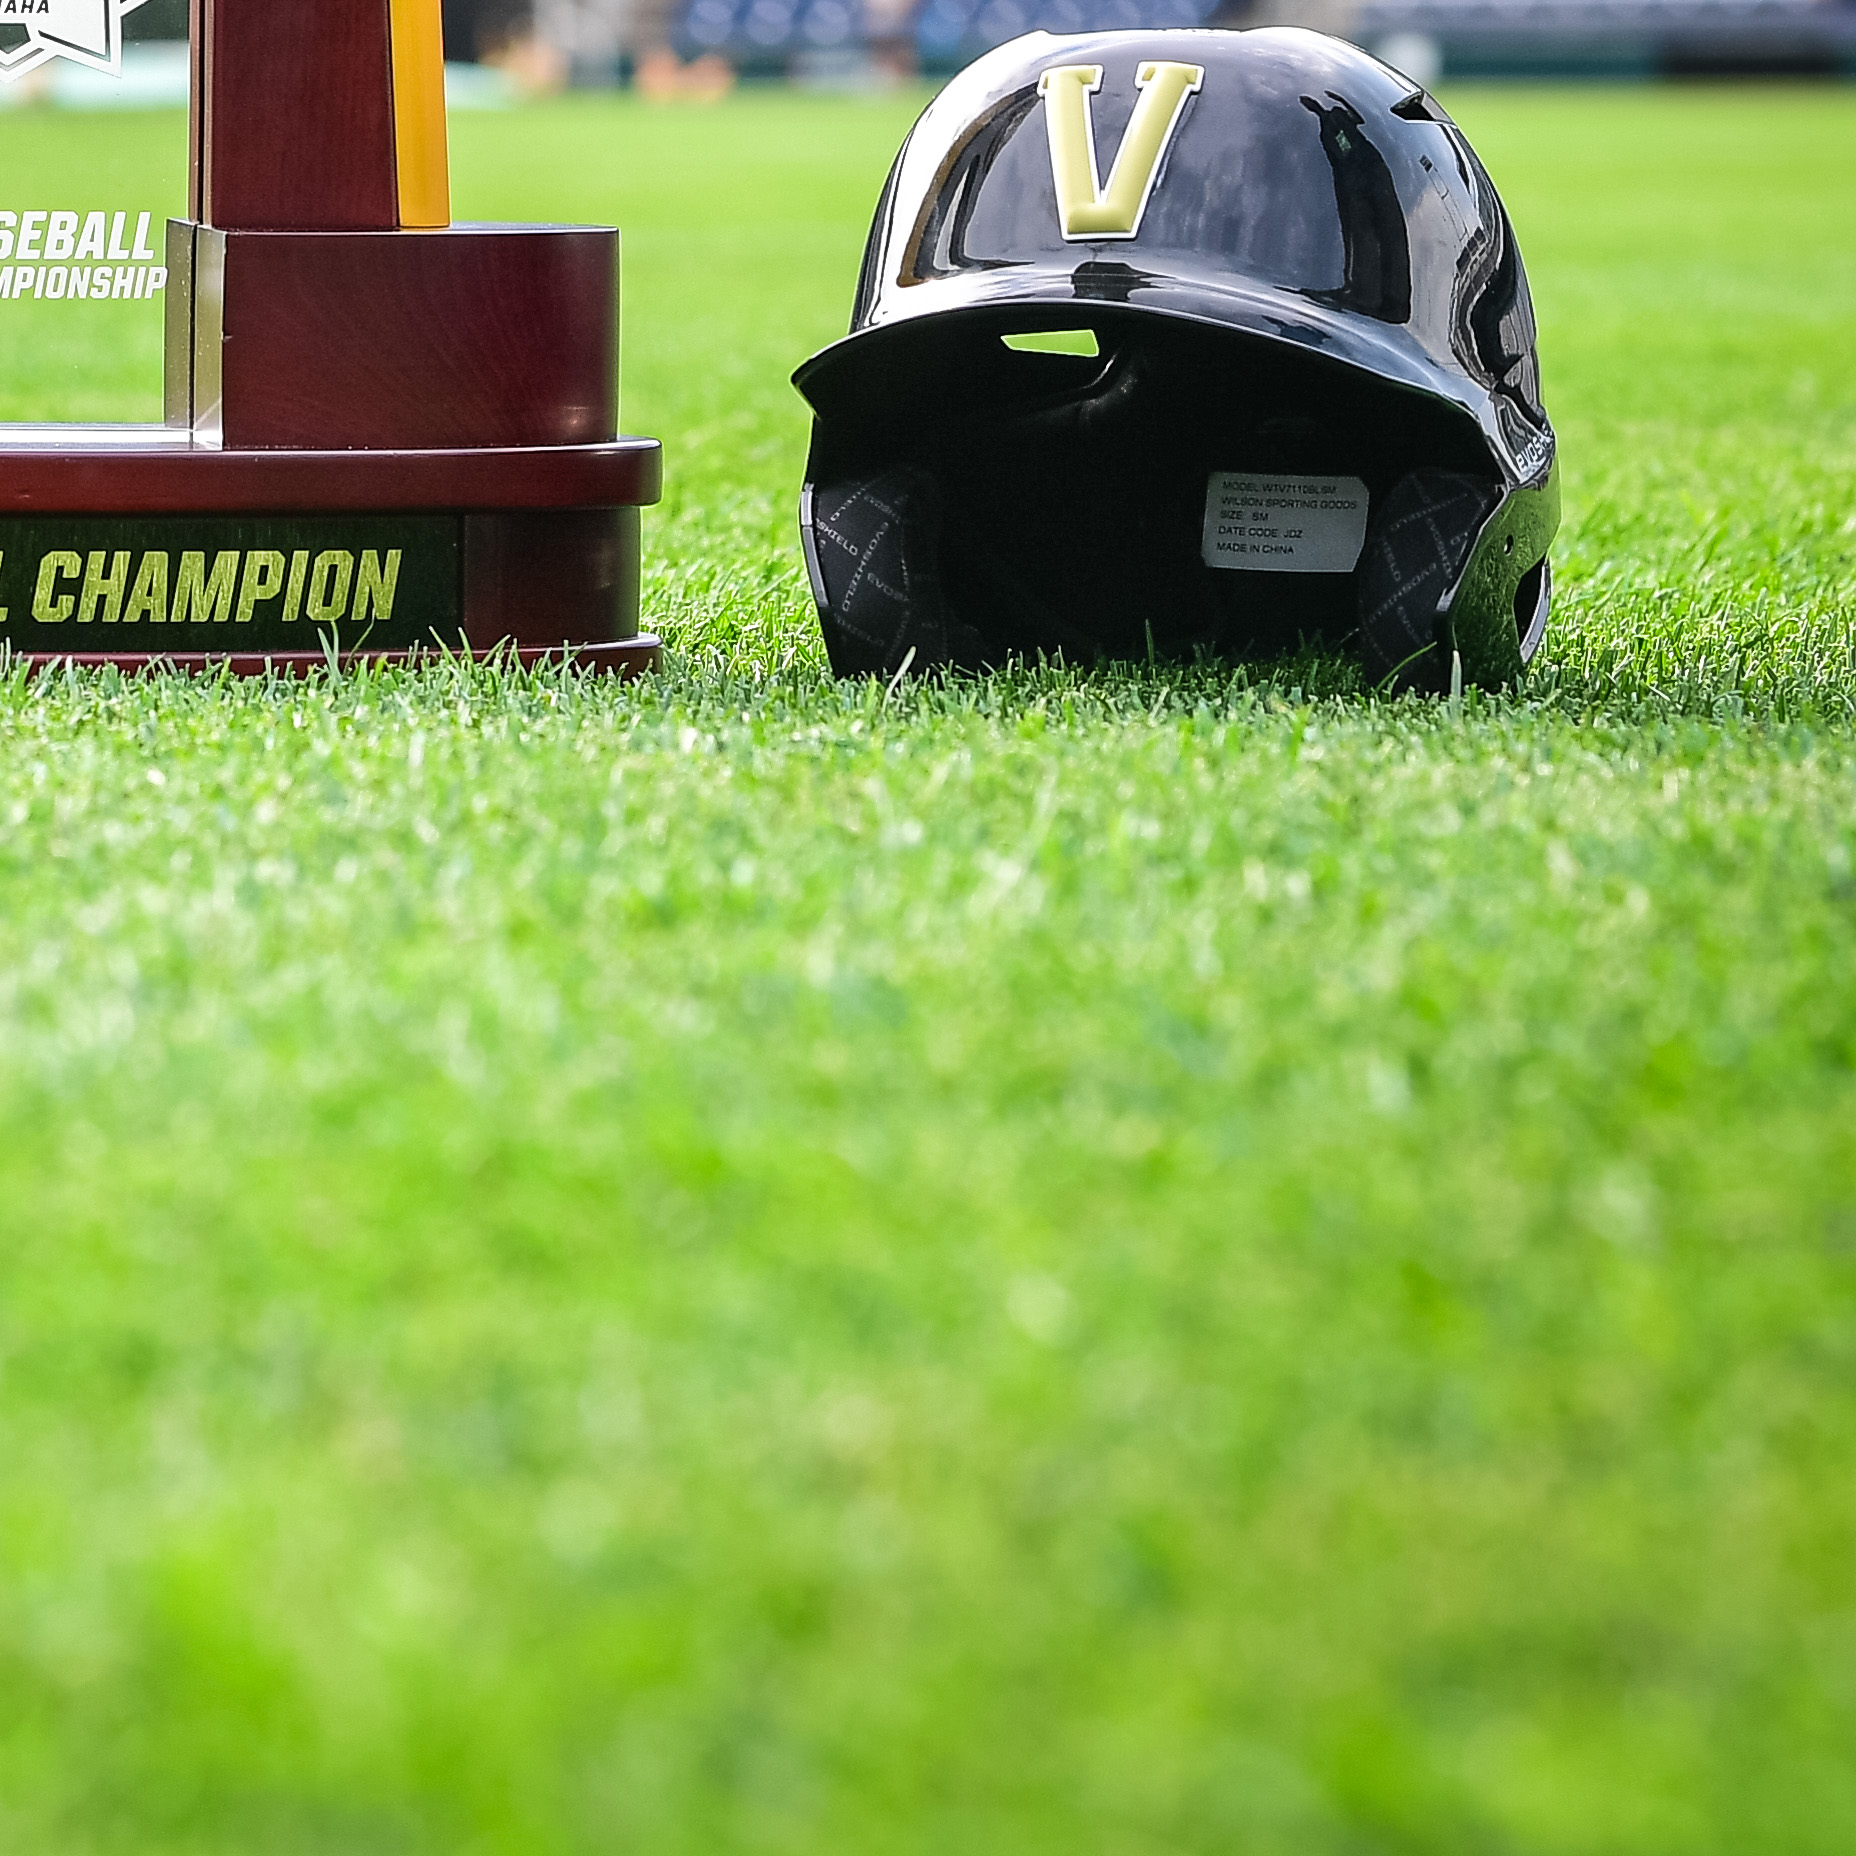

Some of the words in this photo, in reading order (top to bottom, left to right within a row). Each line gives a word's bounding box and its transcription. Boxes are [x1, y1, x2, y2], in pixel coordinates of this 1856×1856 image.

[1036, 60, 1205, 242] V
[1222, 496, 1263, 507] WILSON
[1265, 498, 1317, 509] SPORTING
[1320, 499, 1357, 510] GOODS
[1252, 511, 1269, 521] SM
[1218, 525, 1245, 536] DATE
[1248, 527, 1278, 538] CODE
[1216, 541, 1245, 553] MADE
[1249, 543, 1261, 553] IN
[1262, 544, 1295, 555] CHINA
[31, 548, 402, 622] CHAMPION
